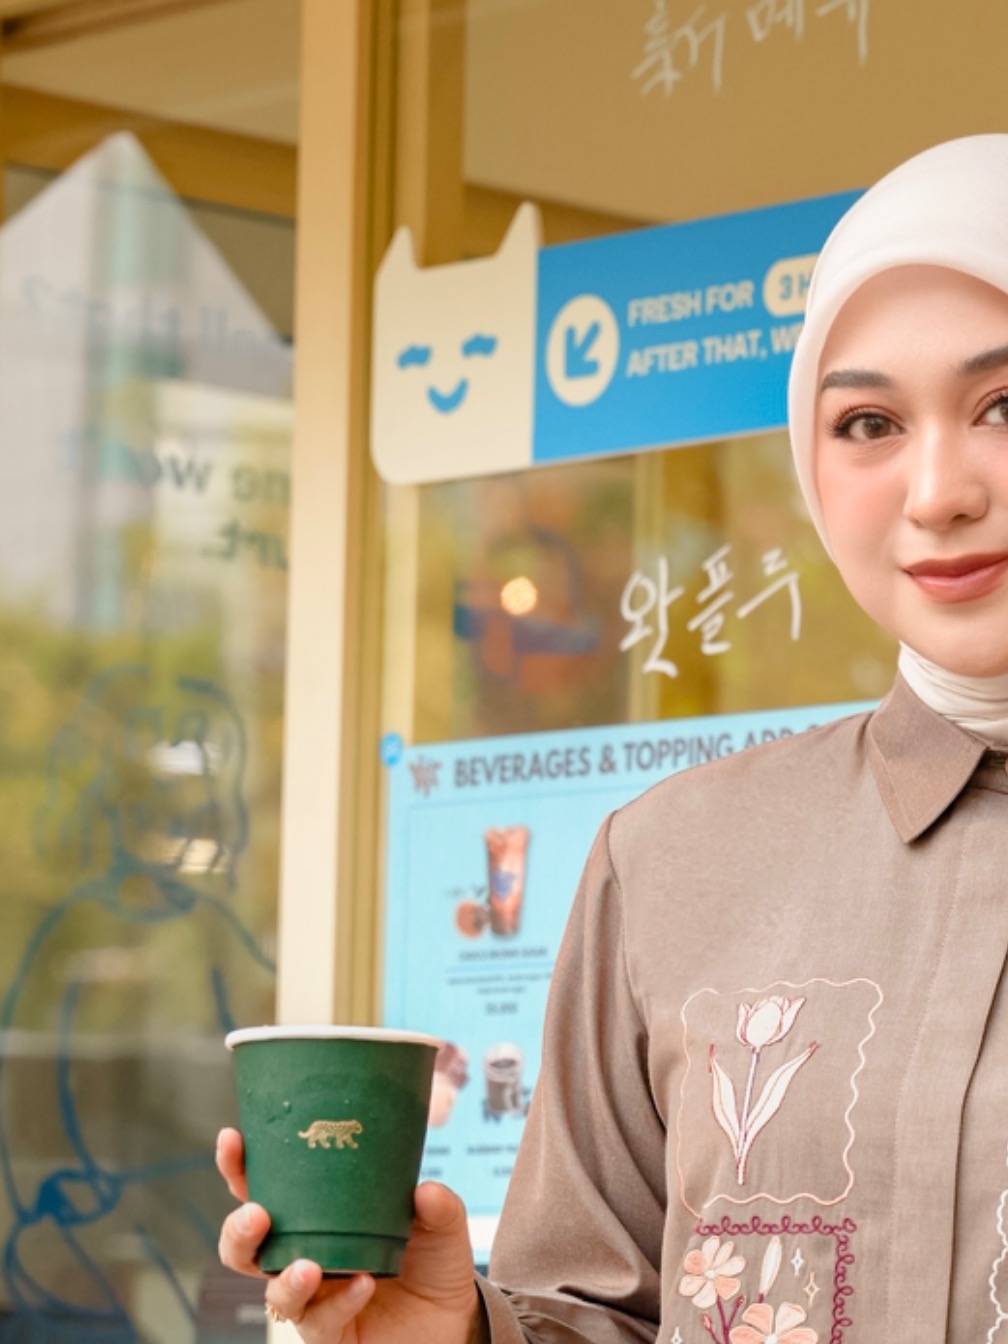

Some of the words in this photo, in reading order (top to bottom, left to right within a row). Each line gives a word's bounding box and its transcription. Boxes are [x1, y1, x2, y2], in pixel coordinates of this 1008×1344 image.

[628, 290, 701, 327] FRESH
[706, 280, 755, 313] FOR
[778, 274, 794, 301] 3
[625, 340, 699, 378] AFTER
[702, 329, 768, 365] THAT,
[454, 748, 592, 788] BEVERAGES
[598, 743, 617, 774] &
[623, 733, 734, 772] TOPPING
